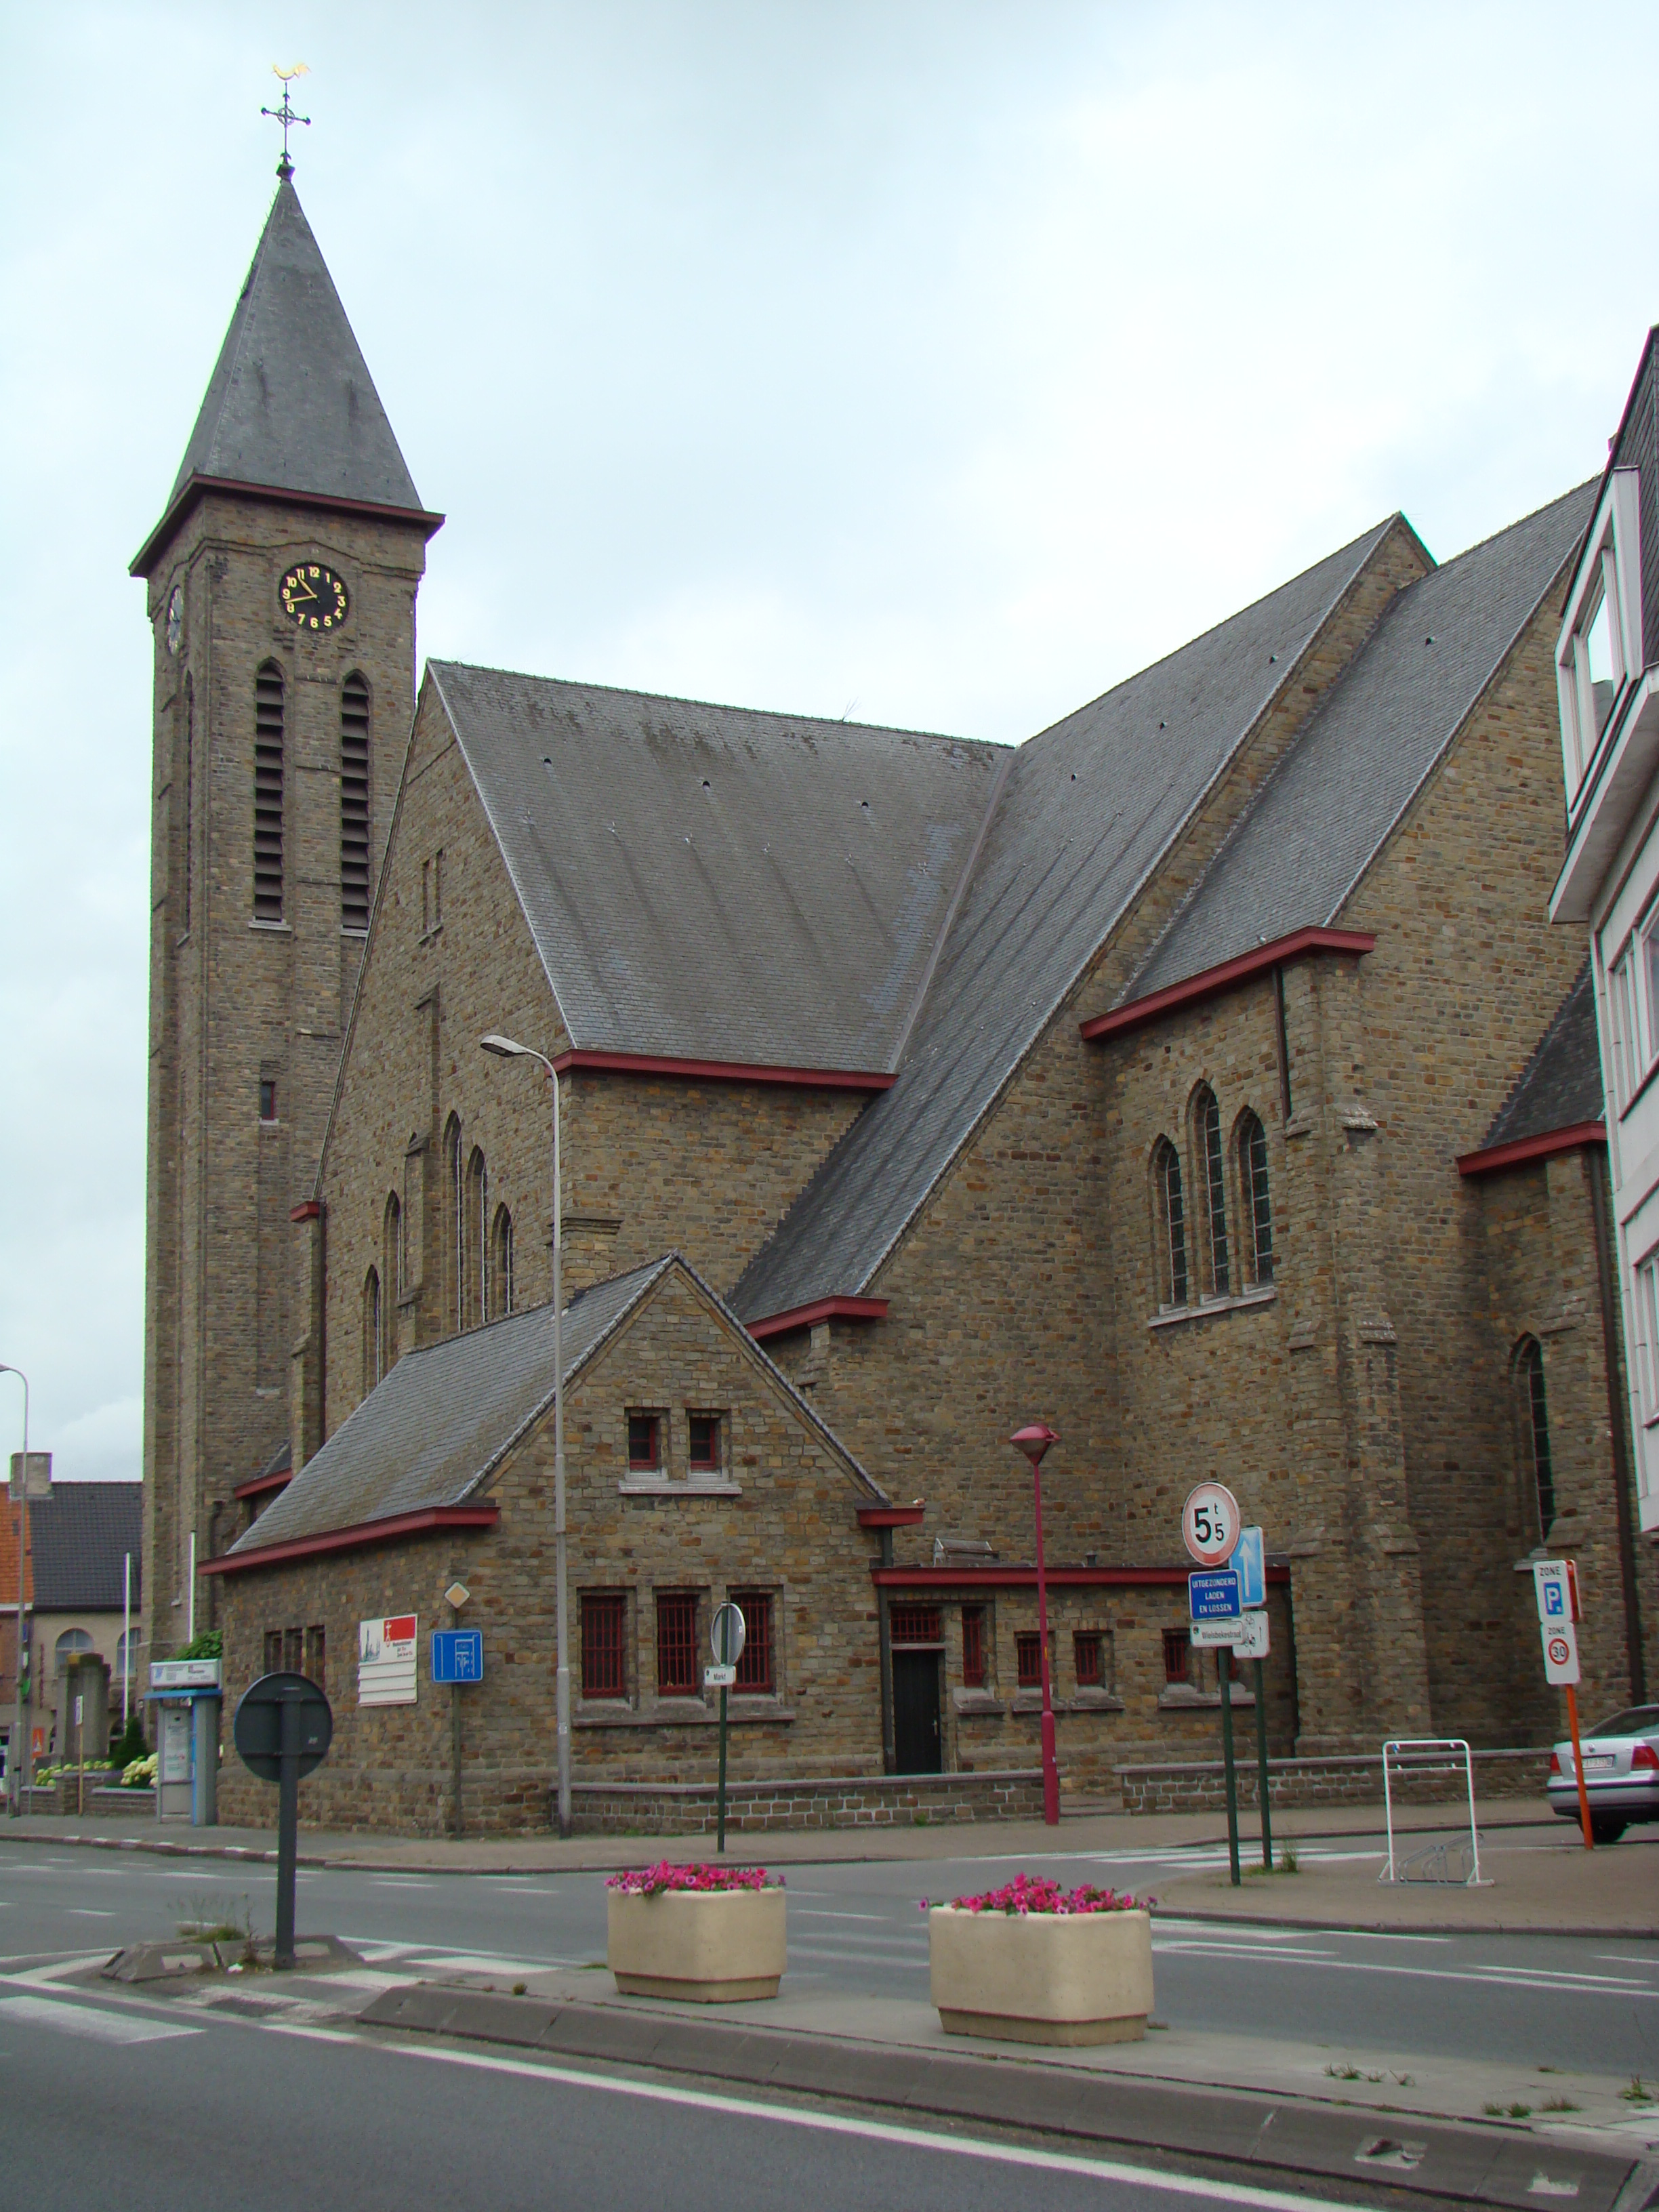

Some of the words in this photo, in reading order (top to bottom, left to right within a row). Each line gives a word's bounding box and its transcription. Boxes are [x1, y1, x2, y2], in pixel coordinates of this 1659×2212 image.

[296, 568, 305, 580] 11
[309, 566, 320, 578] 12
[326, 573, 331, 583] 1
[287, 576, 298, 588] 10
[333, 582, 342, 594] 2
[282, 588, 291, 600] 9
[287, 602, 295, 613] 8
[337, 596, 346, 607] 3
[298, 613, 306, 625] 7
[333, 608, 343, 619] 4
[310, 617, 319, 629] 6
[324, 615, 332, 627] 5
[1539, 1566, 1561, 1576] ZONE
[1192, 1577, 1237, 1589] UITGEZONDERD
[1205, 1591, 1225, 1600] LADEN
[1546, 1586, 1559, 1610] P
[1199, 1605, 1208, 1614] EN
[1208, 1603, 1232, 1612] LOSSEN
[1552, 1645, 1567, 1658] 30
